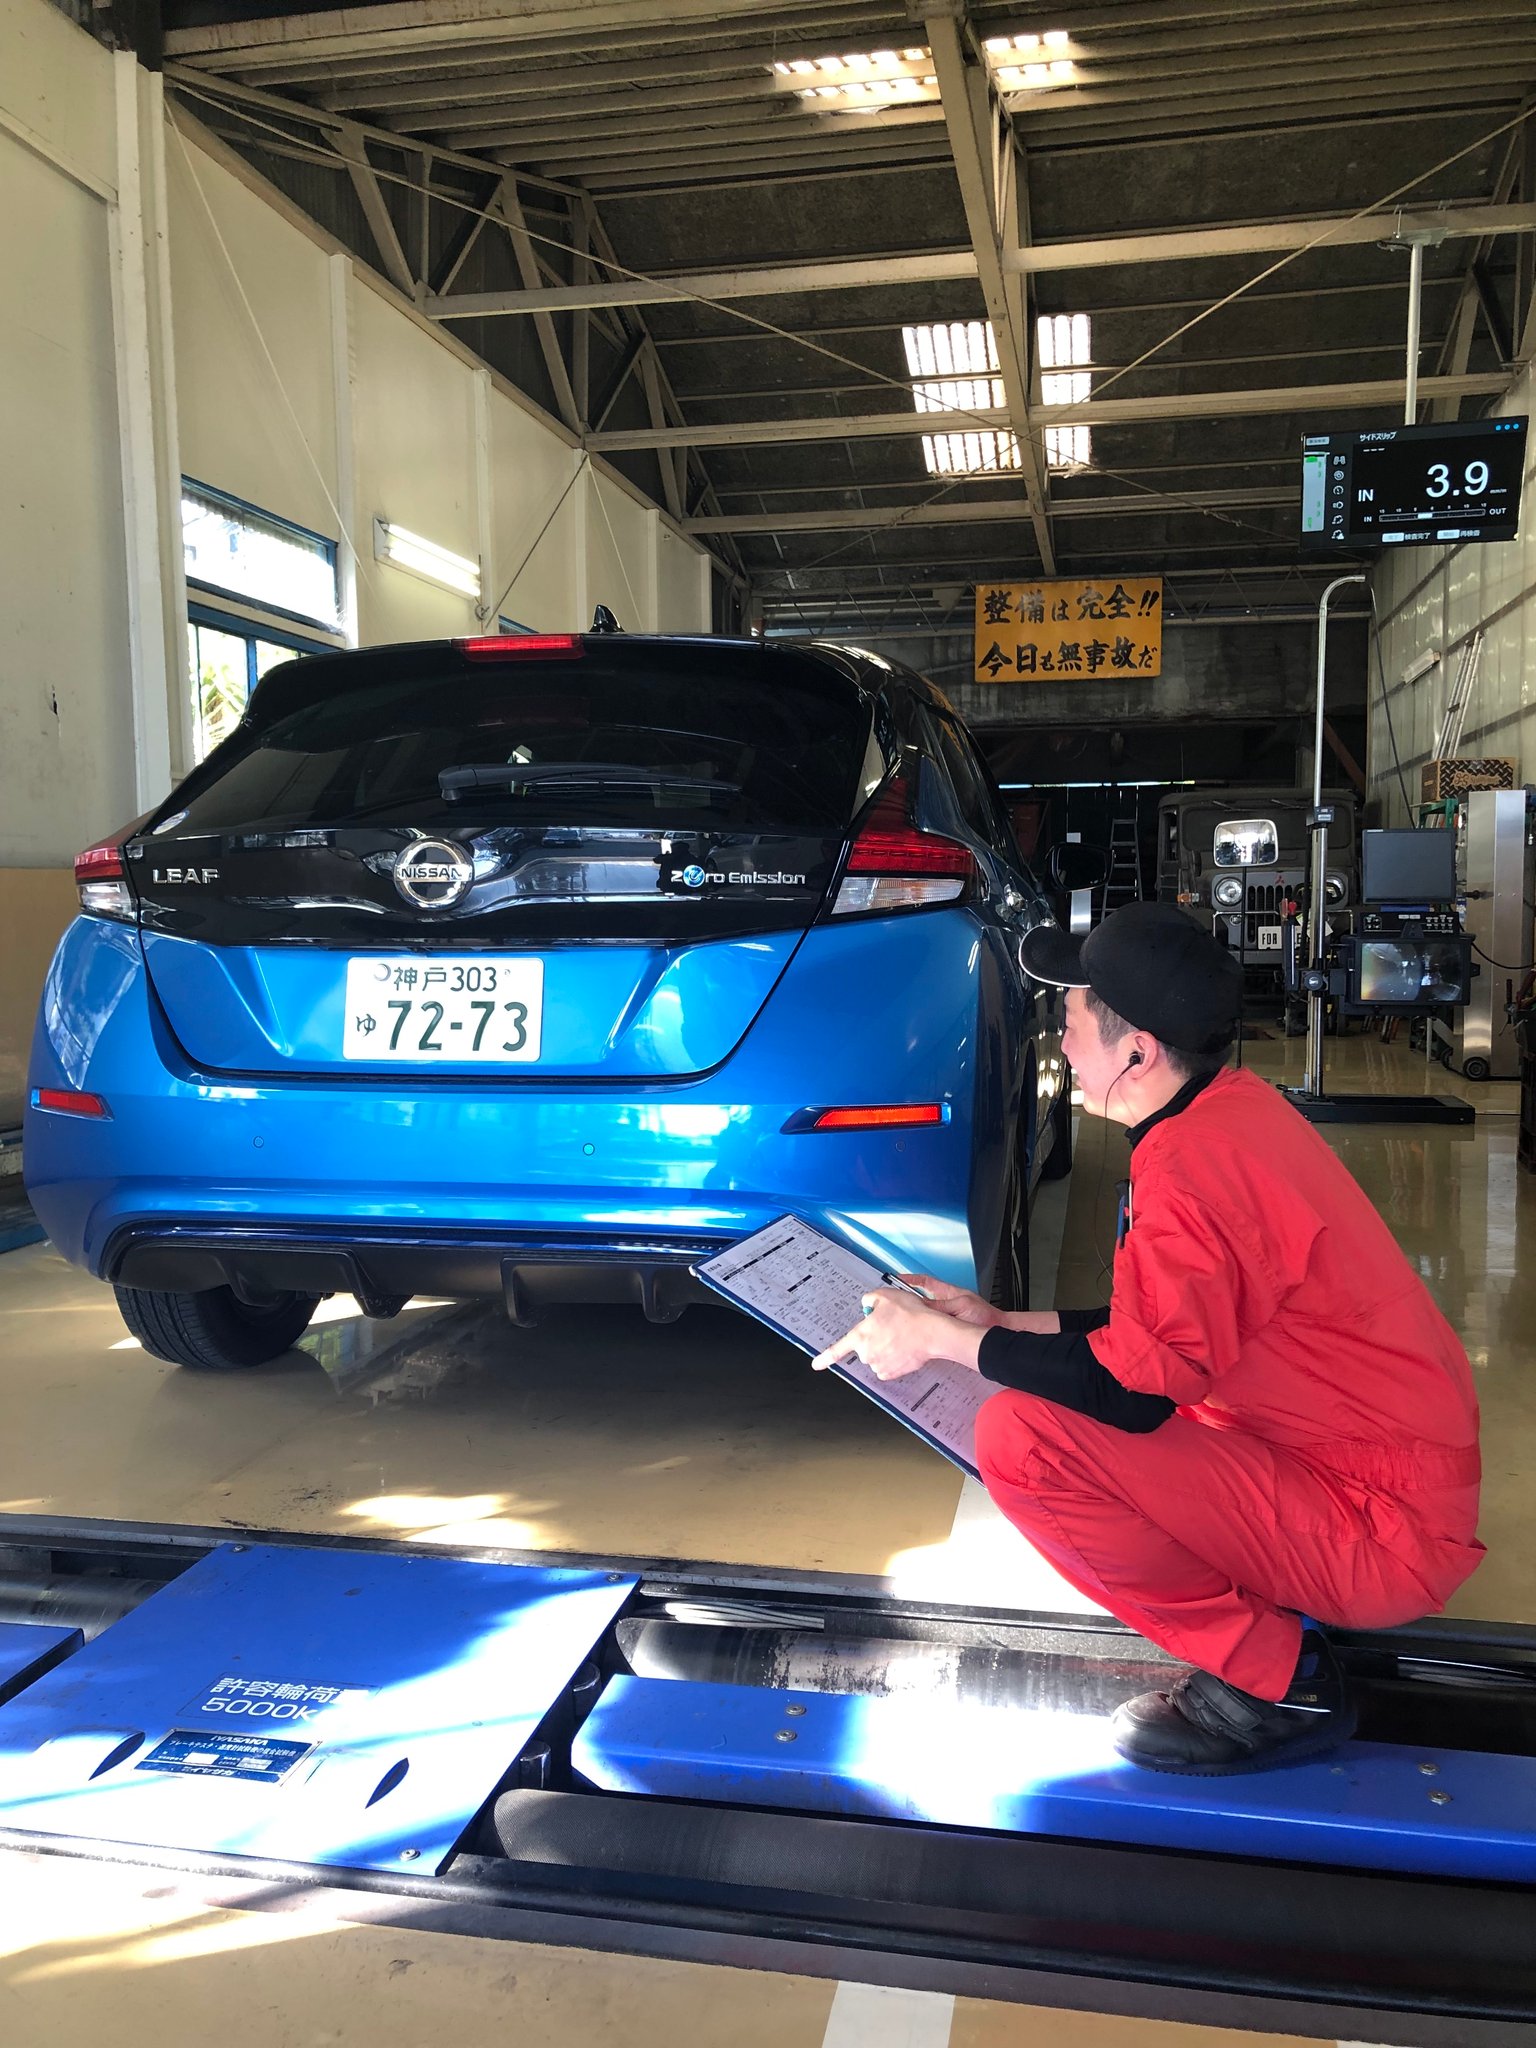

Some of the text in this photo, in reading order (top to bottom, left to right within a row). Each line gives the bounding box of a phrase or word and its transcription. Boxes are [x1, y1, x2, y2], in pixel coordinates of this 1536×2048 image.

[1360, 431, 1397, 442] サイドスリップ
[1425, 460, 1489, 498] 3.9
[1358, 488, 1374, 502] IN
[1489, 507, 1508, 516] OUT
[978, 636, 1158, 678] 今日も無事故だ
[152, 868, 219, 885] LEAF
[401, 867, 463, 880] NISSAN
[728, 871, 806, 885] Emission
[356, 1000, 528, 1051] ゆ 72-73
[210, 1677, 369, 1704] 許容輪荷
[201, 1696, 319, 1721] 5000k
[210, 1735, 269, 1746] IYASAKA
